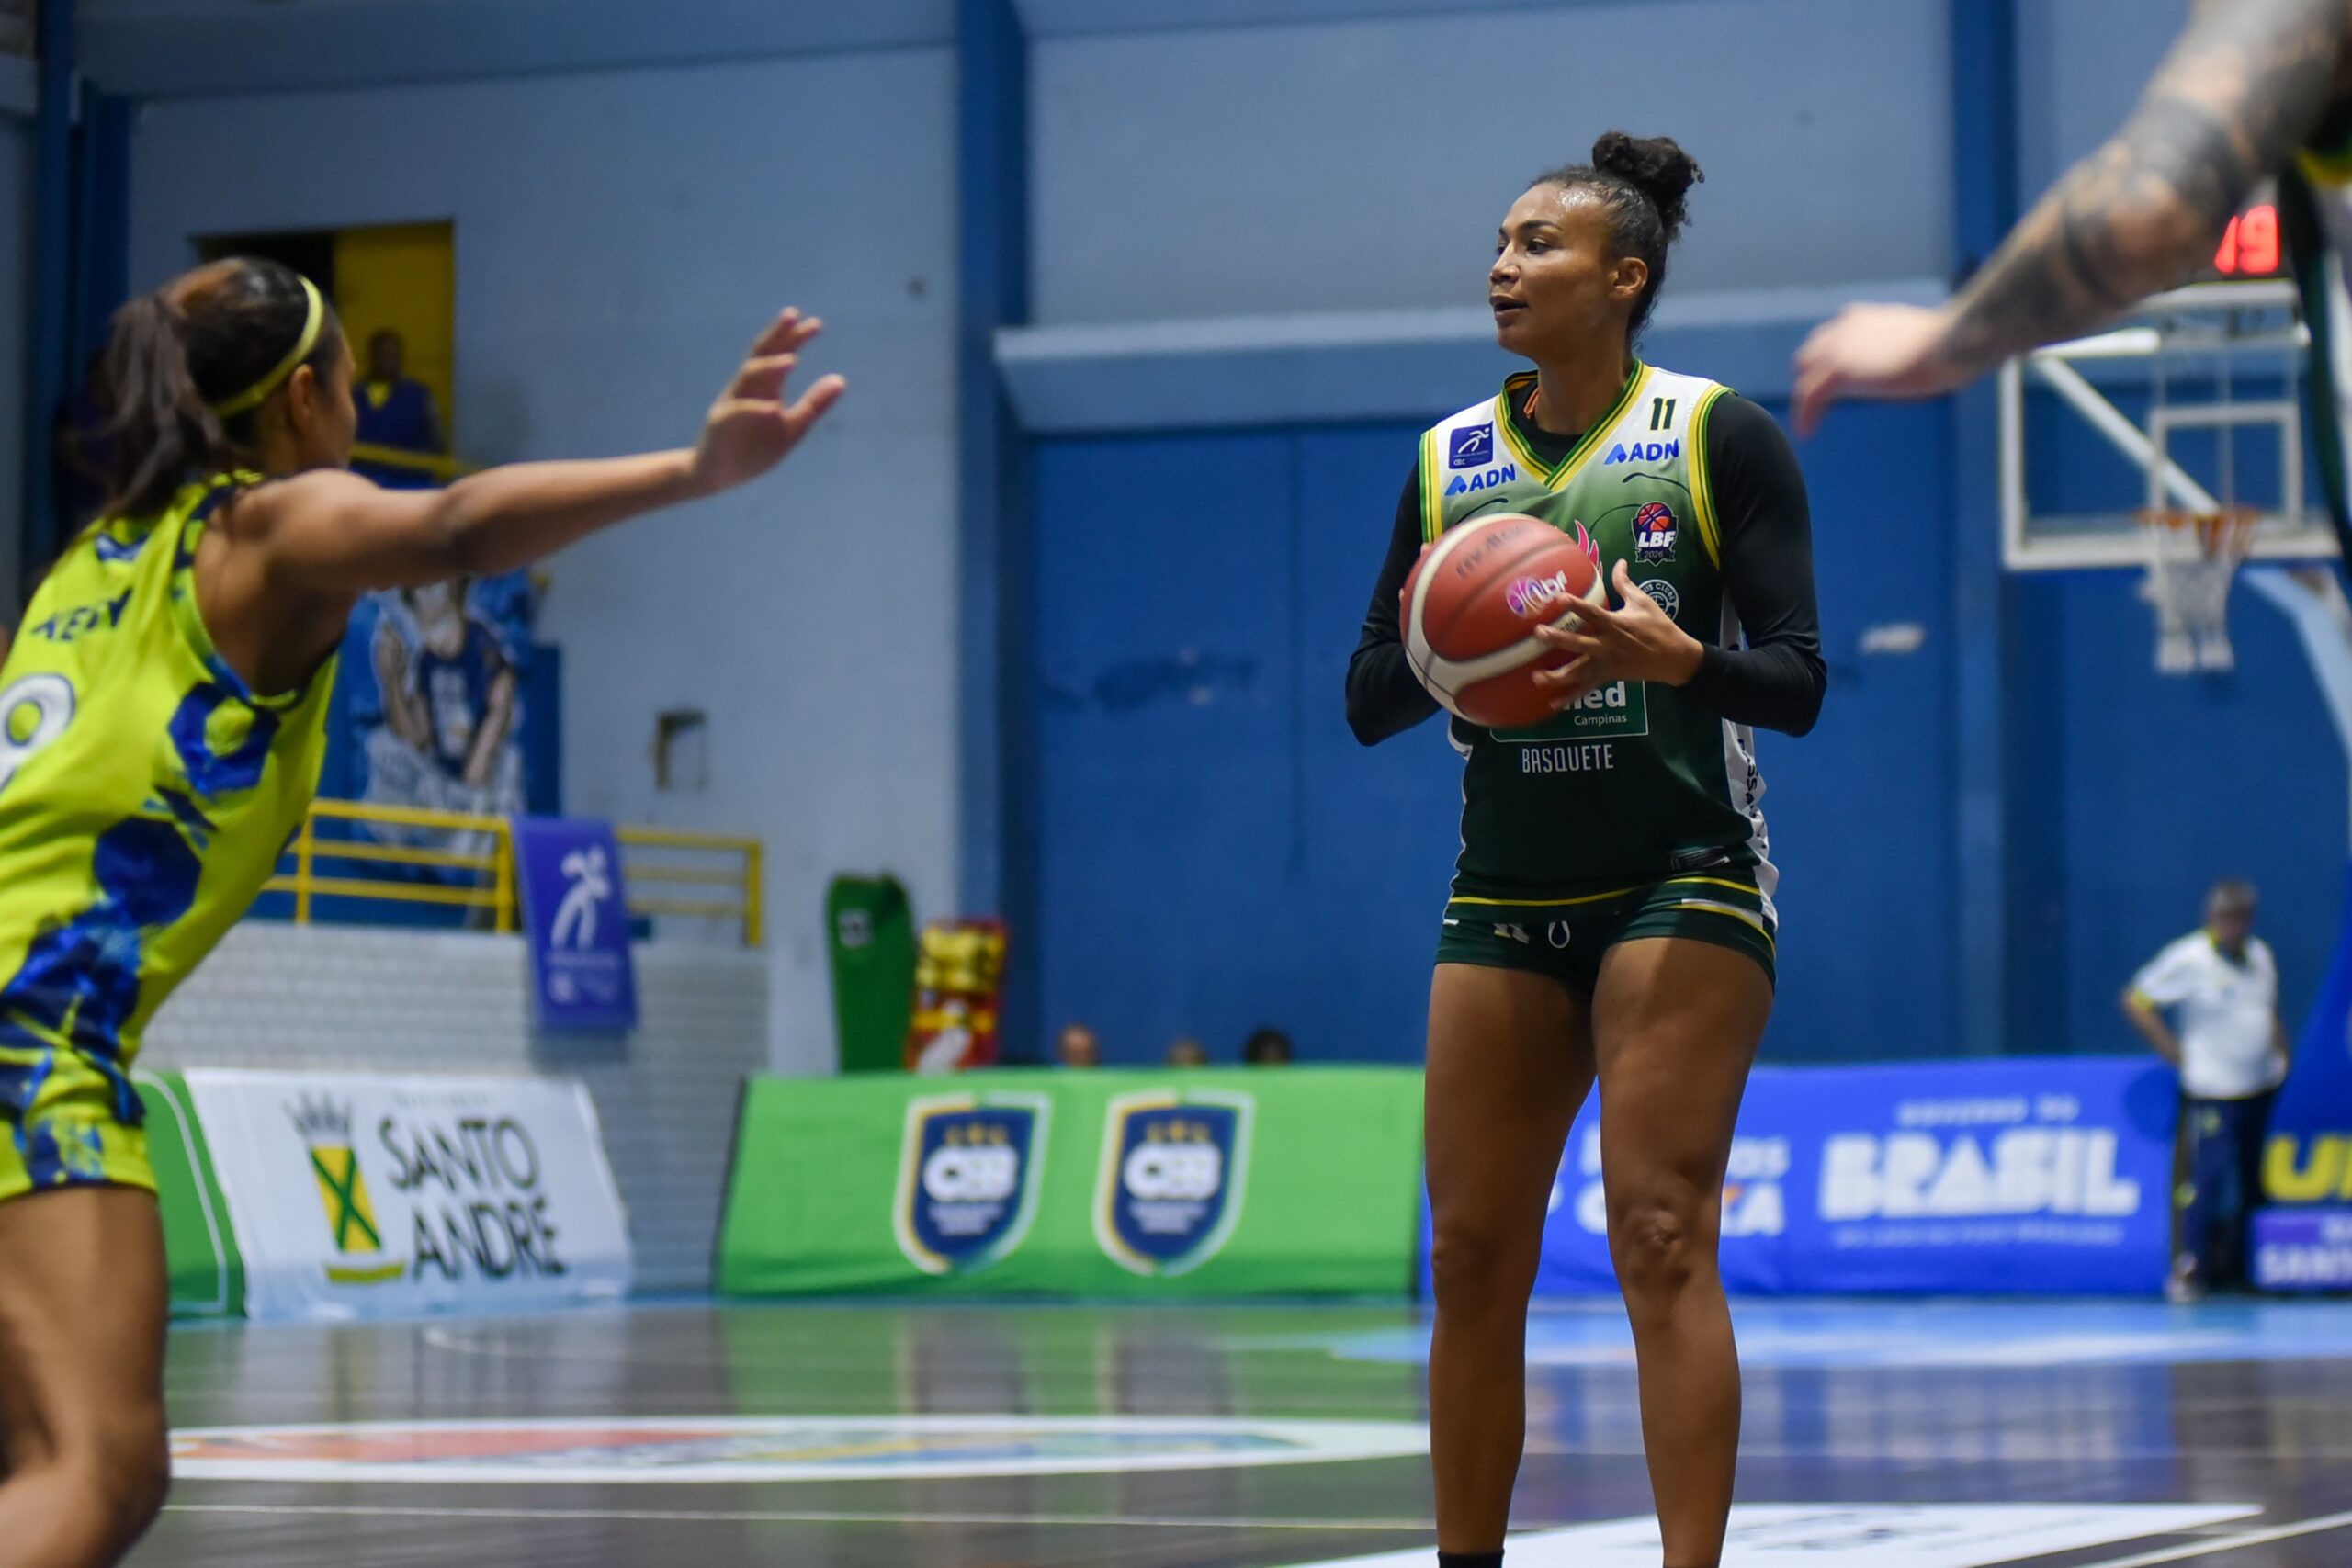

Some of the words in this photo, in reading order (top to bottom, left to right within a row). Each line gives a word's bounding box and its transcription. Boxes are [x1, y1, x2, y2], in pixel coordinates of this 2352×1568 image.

[1650, 397, 1677, 431] 11
[1628, 437, 1680, 463] ADN
[1469, 463, 1516, 492] ADN
[1637, 531, 1677, 548] LBF
[1574, 713, 1627, 727] Campinas
[1521, 744, 1614, 773] BASQUETE
[379, 1117, 540, 1192] SANTO
[1820, 1127, 2141, 1221] BRASIL
